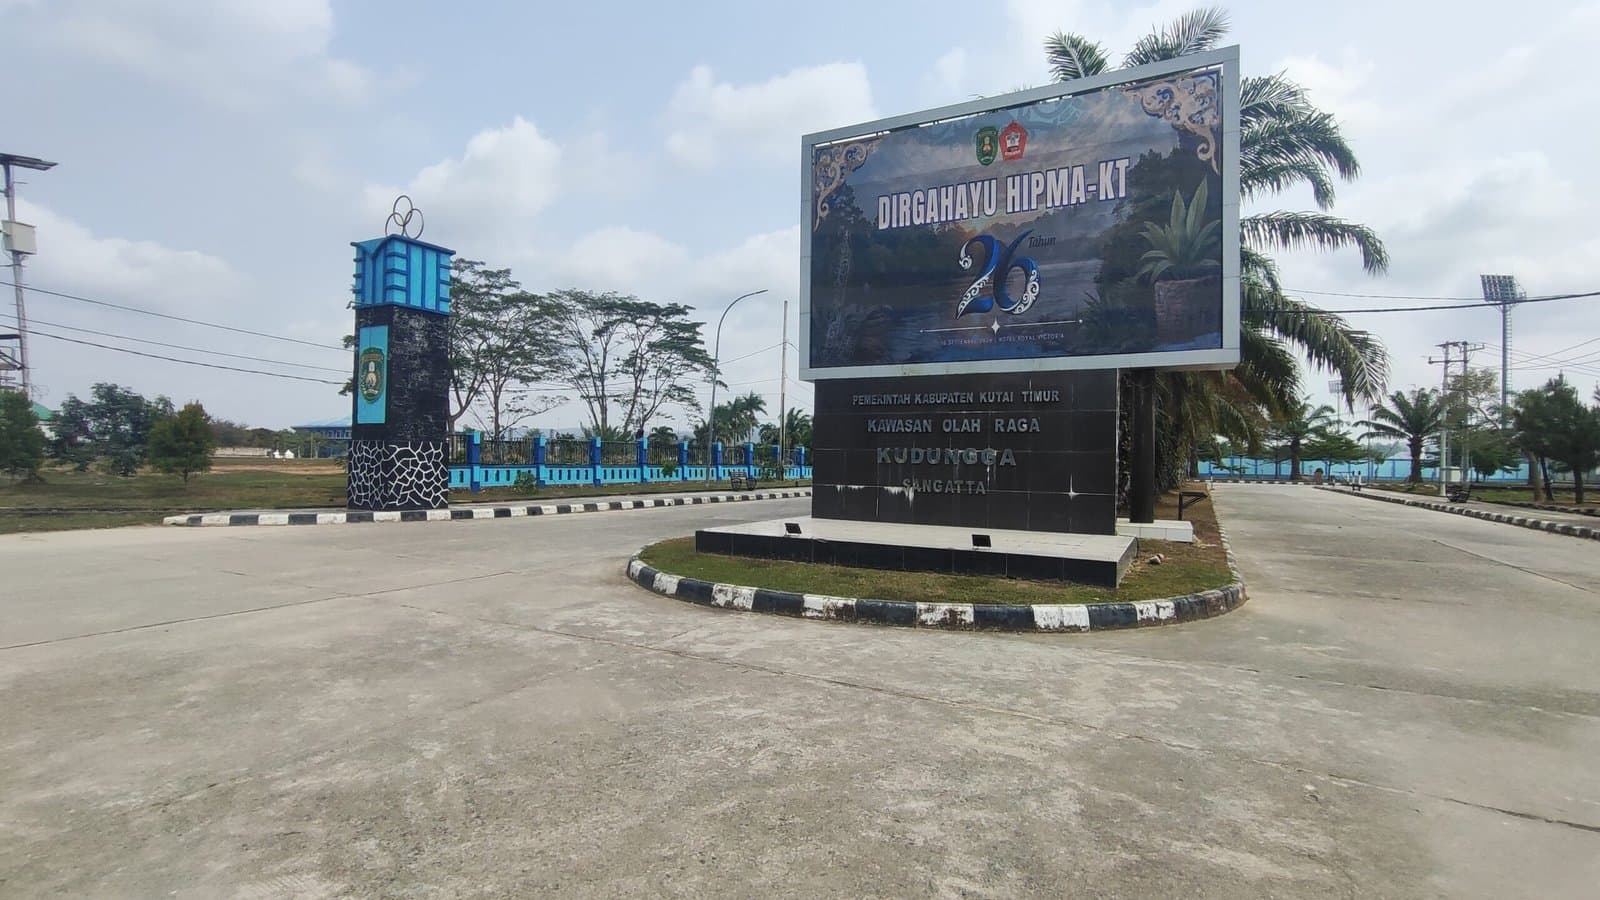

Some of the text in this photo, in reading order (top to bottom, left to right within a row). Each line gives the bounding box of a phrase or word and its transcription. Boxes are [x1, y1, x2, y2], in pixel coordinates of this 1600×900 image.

[878, 157, 1131, 231] DIRGAHAYU HIPMA-KT
[1028, 235, 1056, 248] Tahun
[956, 229, 1041, 320] 26
[852, 389, 1060, 406] PEMERINTAH KABUPATEN KUTAI TIMUR
[867, 417, 1041, 433] KAWASAN OLAH RAGA
[877, 447, 1017, 467] KUDUNGGA
[902, 477, 987, 495] SANGATTA
